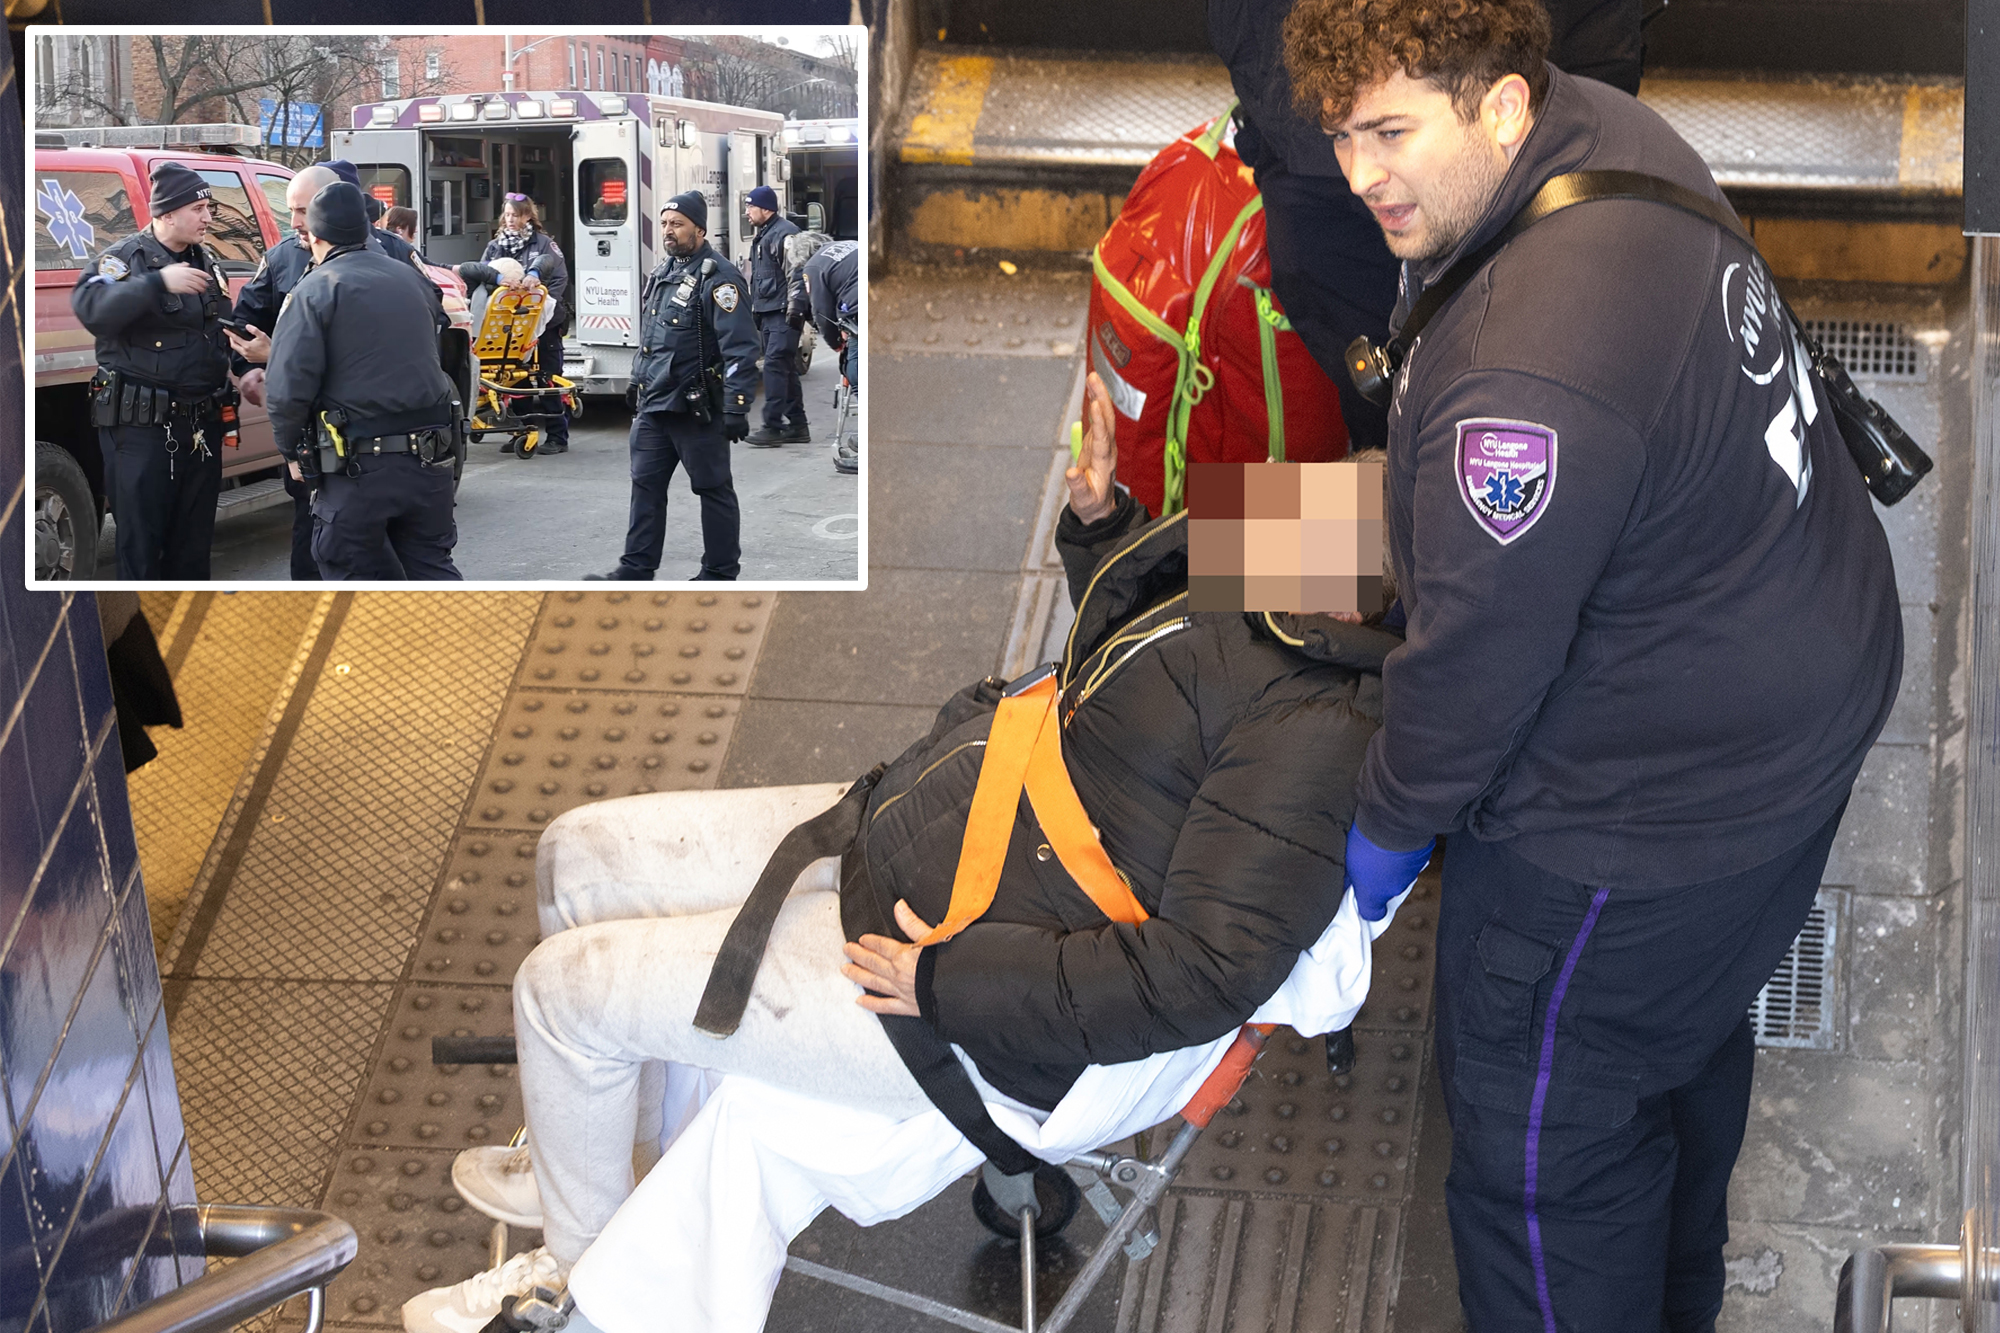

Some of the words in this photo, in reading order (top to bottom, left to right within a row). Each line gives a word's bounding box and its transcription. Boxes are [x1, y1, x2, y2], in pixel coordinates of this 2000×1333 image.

[585, 286, 600, 296] NYU
[600, 287, 628, 298] Langone
[597, 297, 620, 306] Health
[1483, 438, 1498, 449] NYU
[1498, 440, 1528, 452] Langone
[1494, 448, 1519, 458] Health
[1469, 457, 1483, 467] NYU
[1483, 459, 1509, 470] Langone
[1492, 509, 1525, 522] MEDICAL
[1523, 478, 1545, 513] SERVICES
